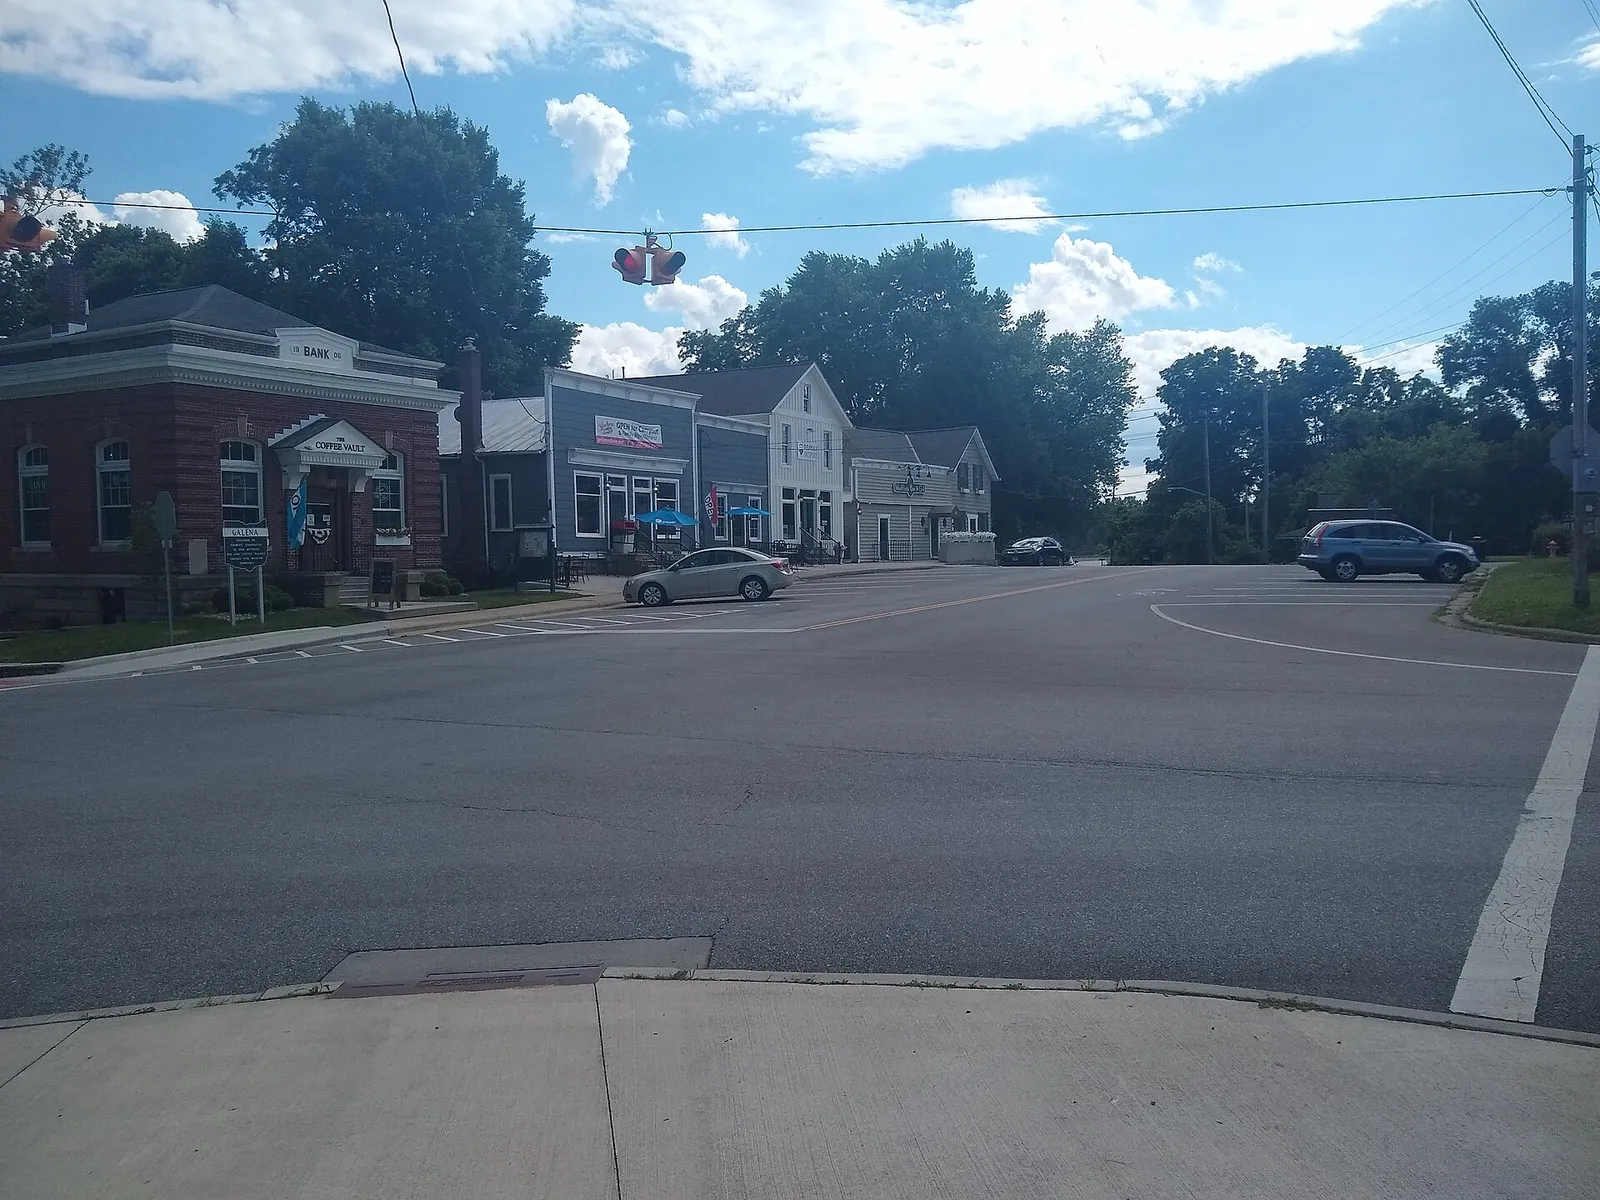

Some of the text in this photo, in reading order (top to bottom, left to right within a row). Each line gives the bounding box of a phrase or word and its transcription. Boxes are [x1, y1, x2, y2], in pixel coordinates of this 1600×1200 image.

[303, 345, 330, 360] BANK
[616, 421, 631, 431] OPEN
[315, 441, 366, 453] COFFEE VAULT
